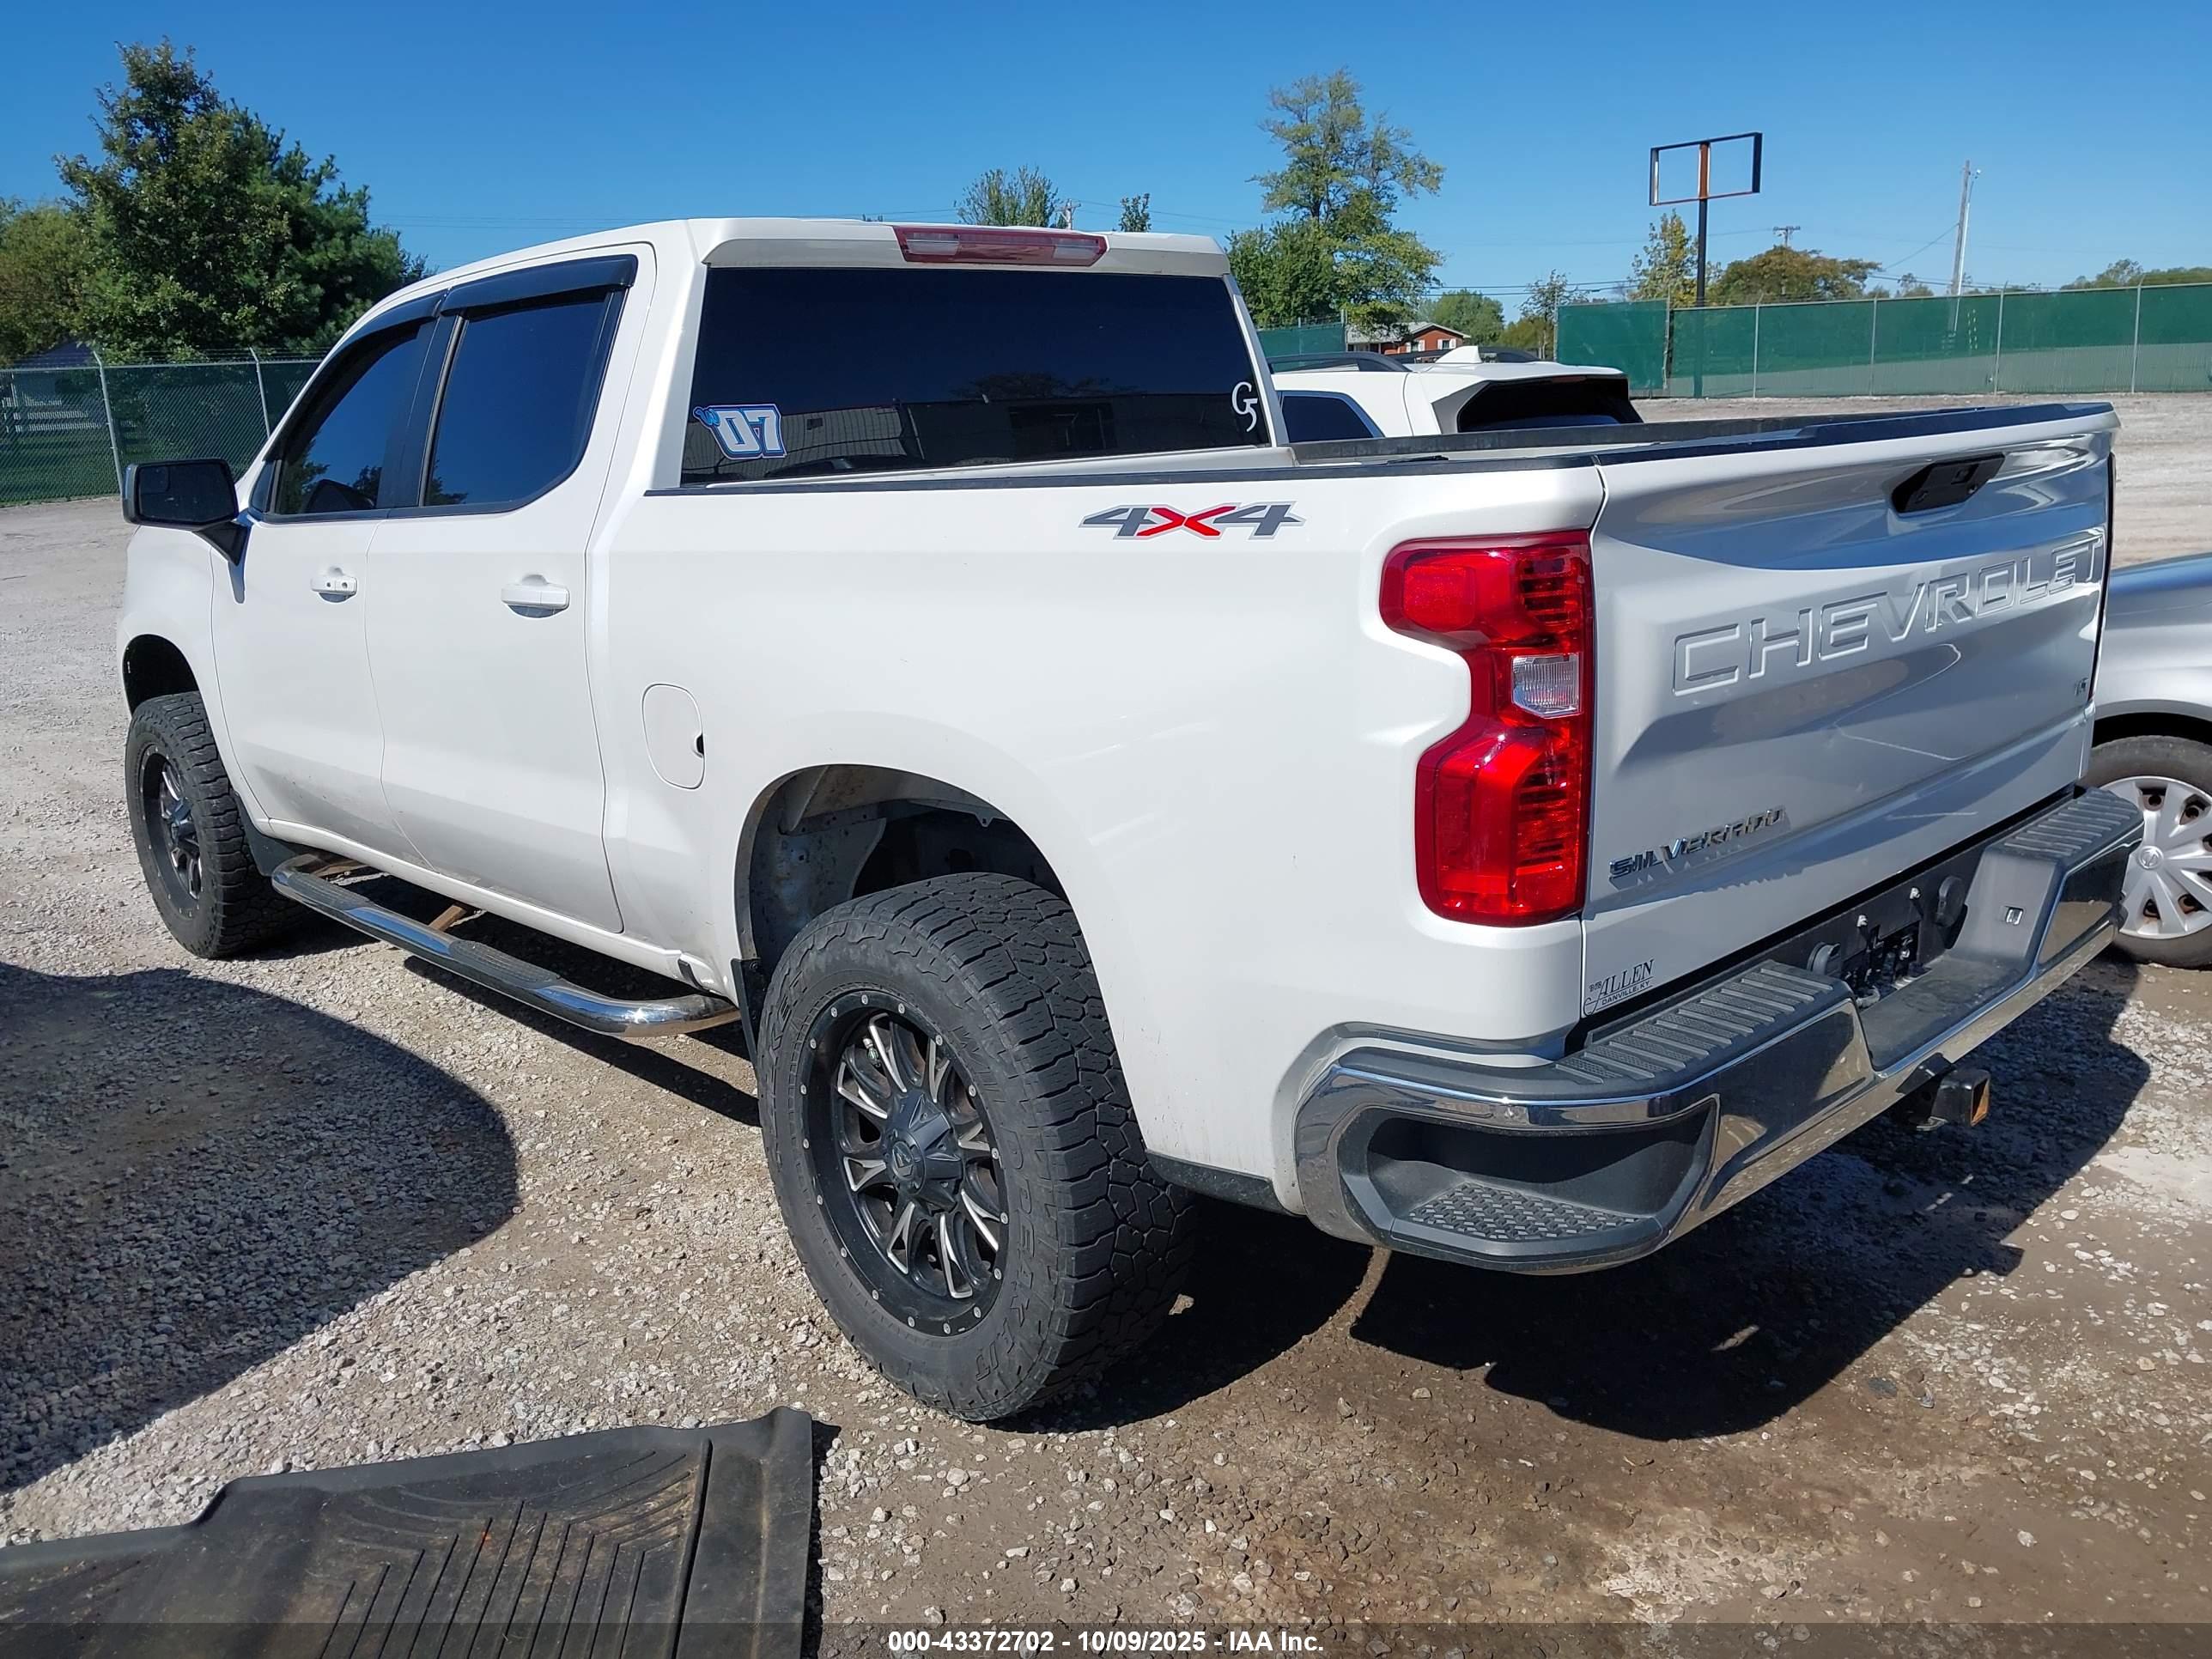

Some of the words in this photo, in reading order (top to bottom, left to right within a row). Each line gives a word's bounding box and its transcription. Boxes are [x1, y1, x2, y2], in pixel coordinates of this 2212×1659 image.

[1672, 526, 2106, 698] CHEVROLET
[1607, 805, 1786, 879] SILVERADO
[1583, 957, 1656, 1017] ALLEN
[1640, 980, 1650, 988] KY
